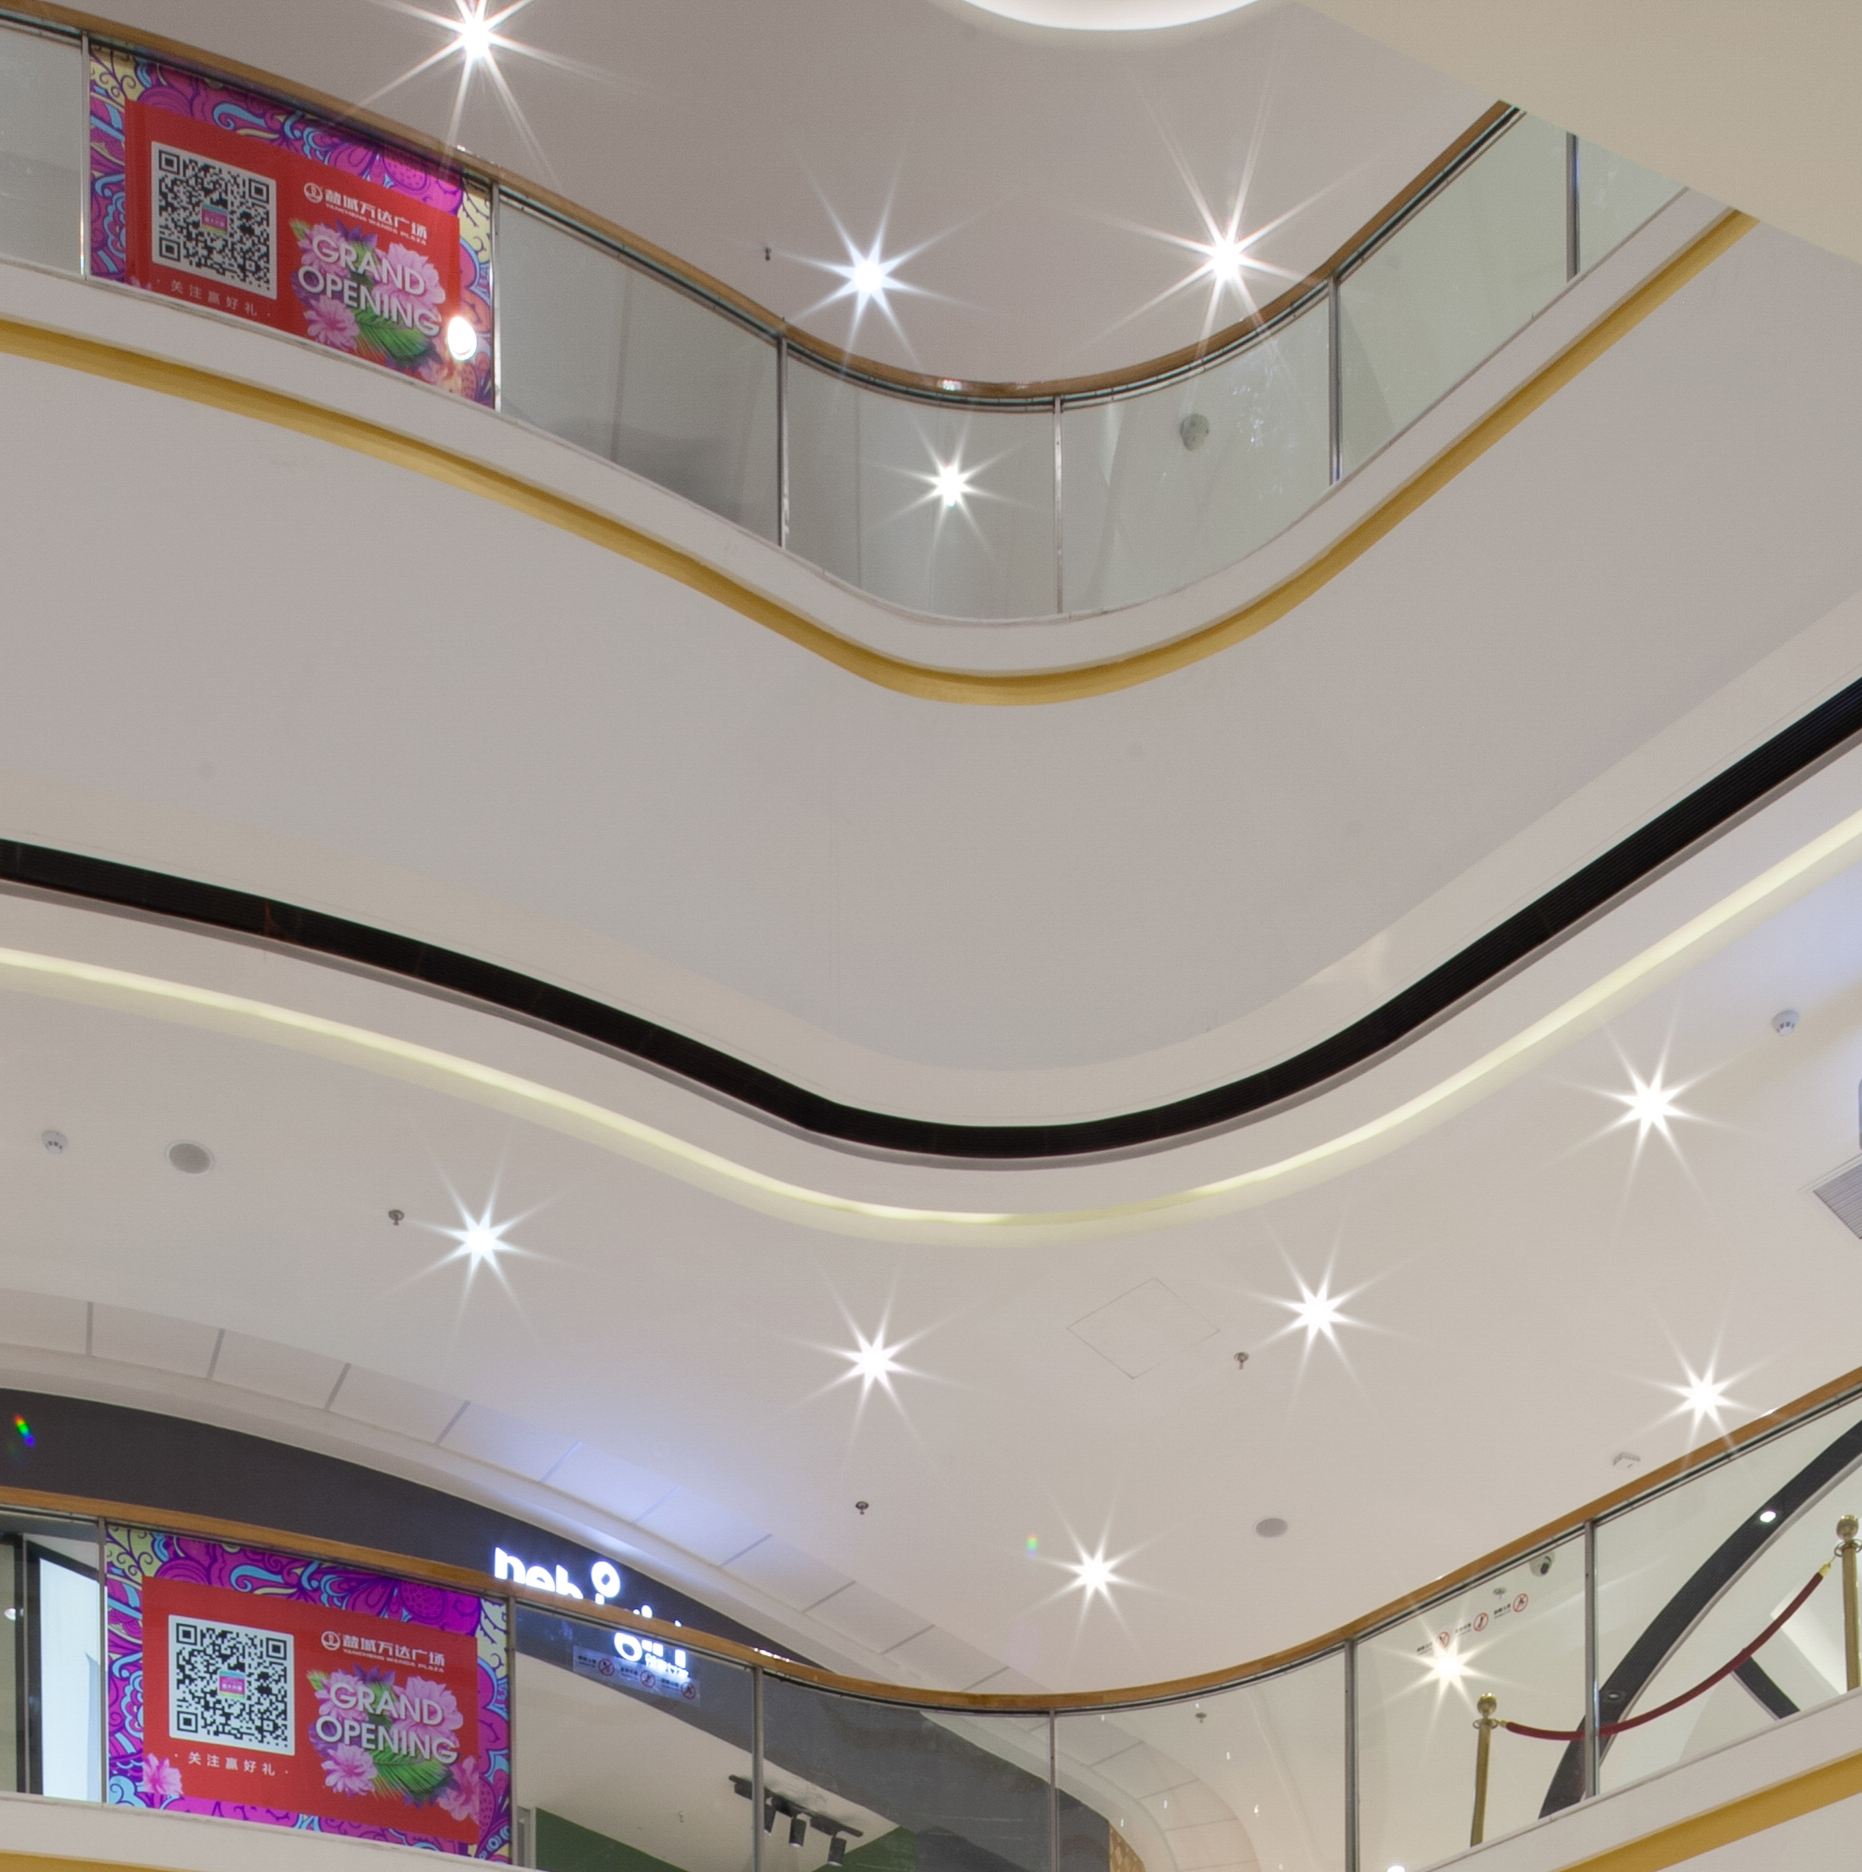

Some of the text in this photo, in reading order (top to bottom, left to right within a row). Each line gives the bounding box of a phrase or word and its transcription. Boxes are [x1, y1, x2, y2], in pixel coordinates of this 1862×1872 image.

[313, 235, 425, 295] GRAND
[171, 280, 257, 316] 关注赢好礼
[298, 266, 441, 336] OPENING
[330, 1682, 443, 1725] GRAND
[316, 1716, 458, 1764] OPENING
[189, 1751, 275, 1776] 关注赢好礼
